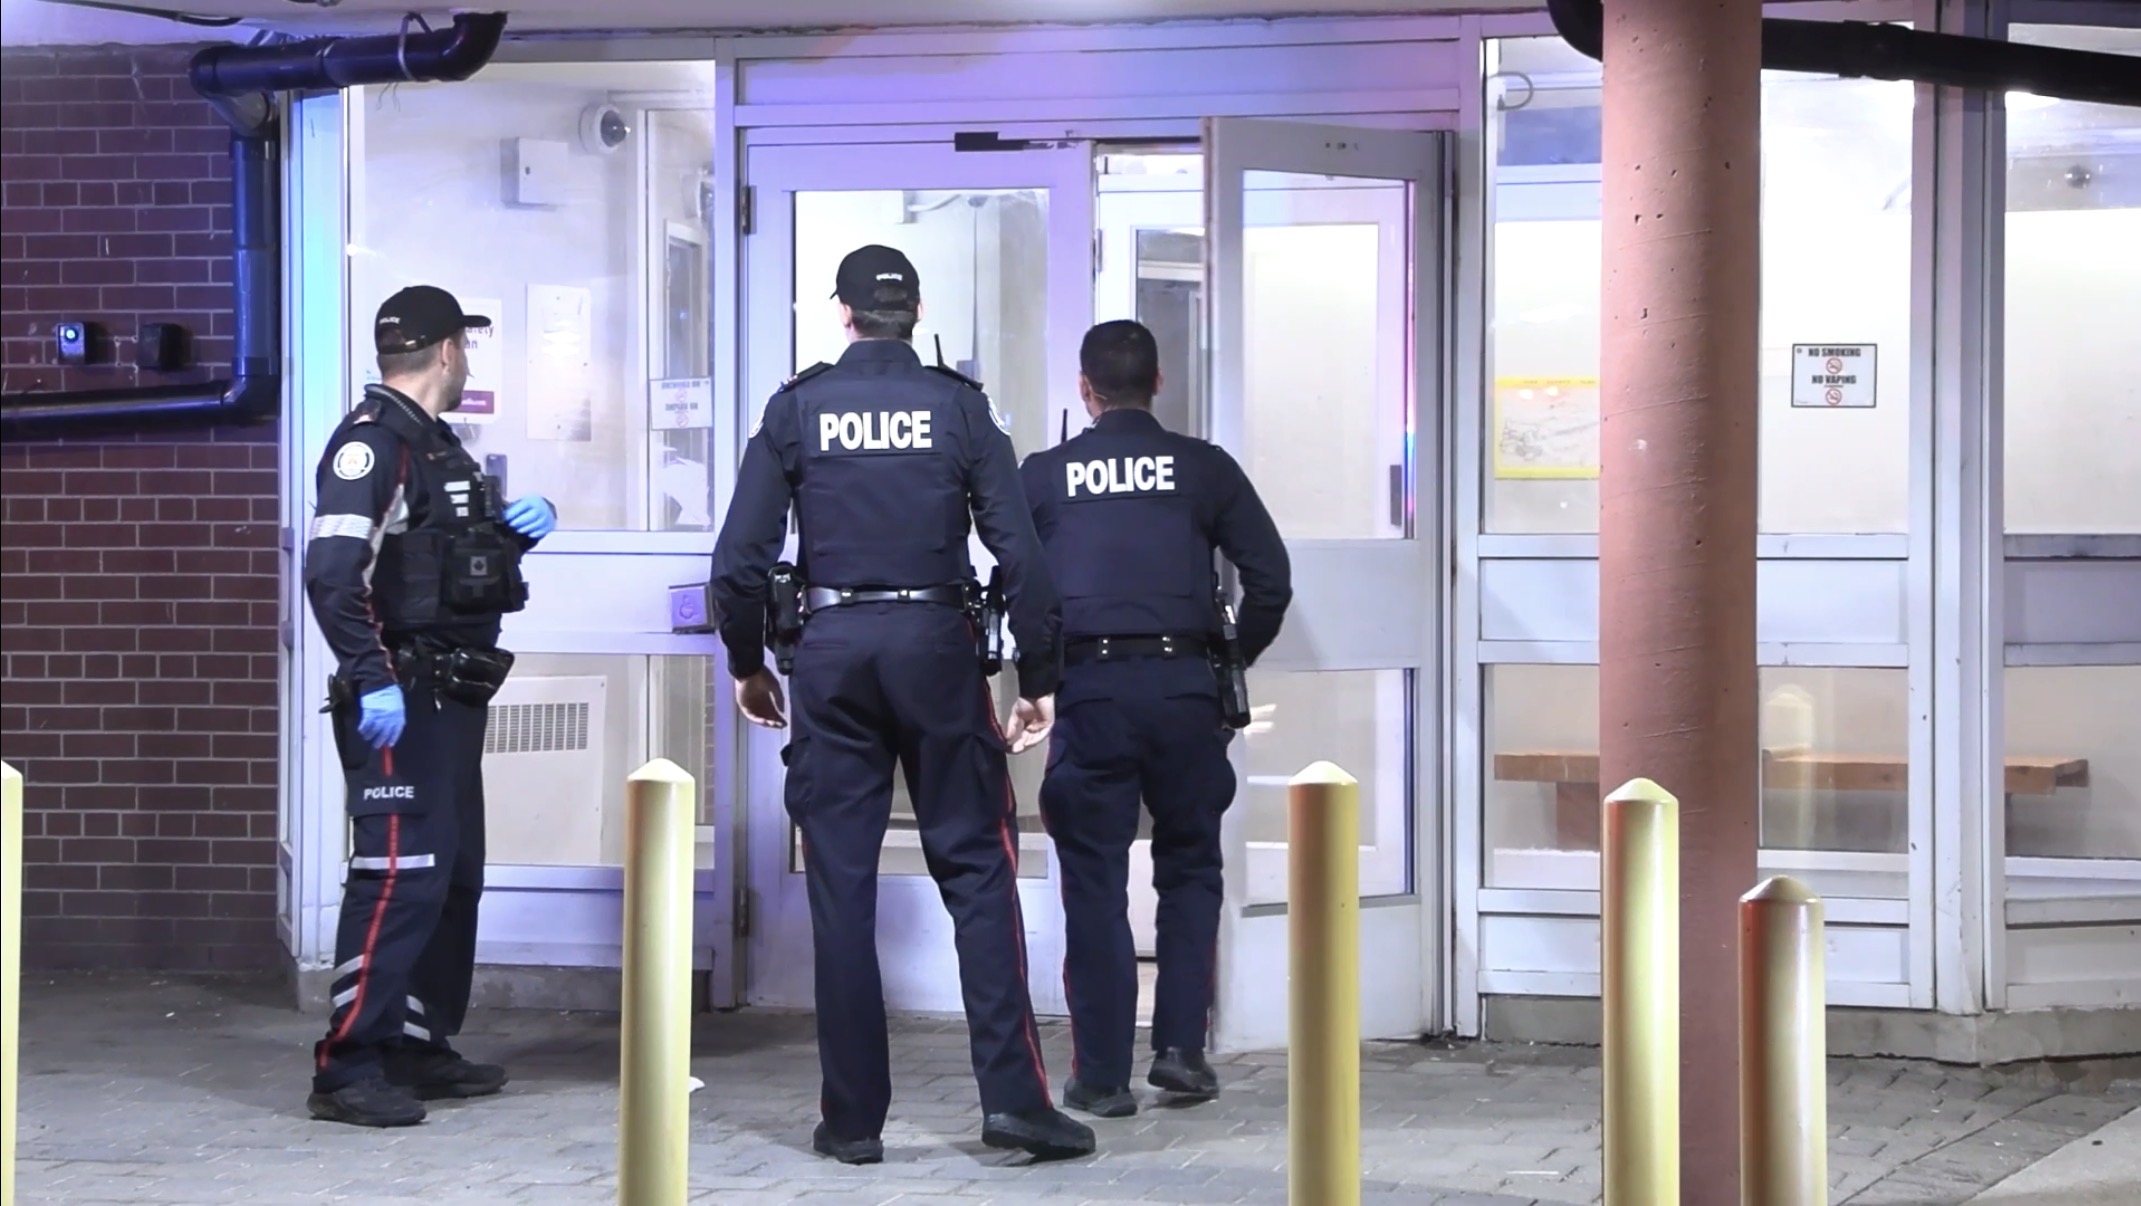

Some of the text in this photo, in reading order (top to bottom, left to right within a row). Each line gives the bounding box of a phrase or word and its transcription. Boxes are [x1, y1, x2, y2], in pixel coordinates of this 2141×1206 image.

[1808, 348, 1861, 357] NO SMOKING
[1811, 375, 1856, 384] NO VAPING
[819, 410, 933, 451] POLICE
[1066, 456, 1176, 497] POLICE
[363, 786, 415, 800] POLICE
